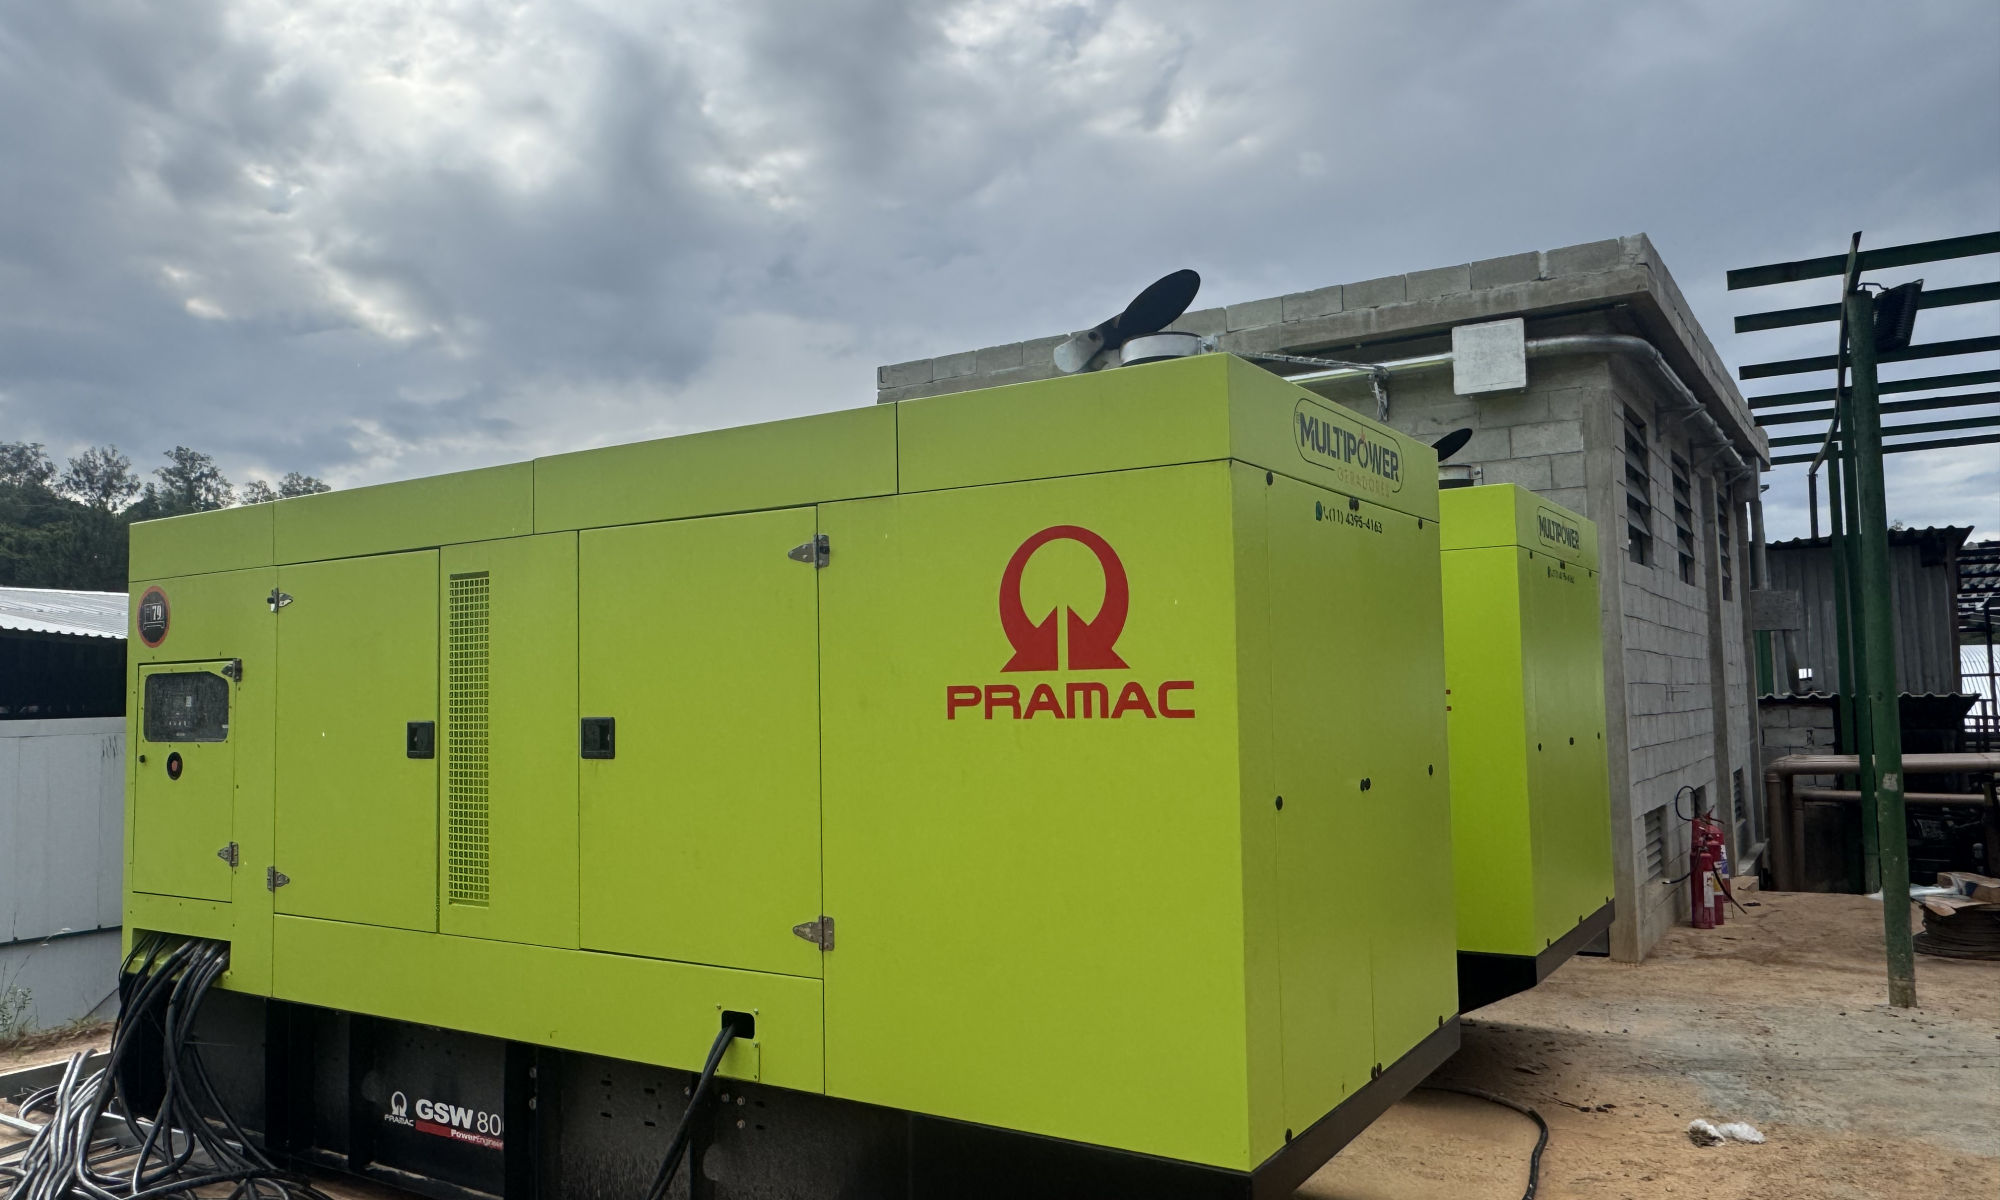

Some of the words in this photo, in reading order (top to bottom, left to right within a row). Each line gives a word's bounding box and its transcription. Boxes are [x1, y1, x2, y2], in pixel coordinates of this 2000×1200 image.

[1299, 411, 1399, 482] MULTIPOWER
[1337, 466, 1390, 498] GERADORES
[1328, 508, 1344, 525] (11)
[1345, 512, 1383, 534] 4395-4163
[1538, 514, 1580, 550] MULTIPOWER
[152, 605, 162, 620] 79
[947, 680, 1196, 720] PRAMAC
[384, 1114, 414, 1127] PRAMAC
[415, 1098, 474, 1130] GSW
[477, 1111, 504, 1136] 80
